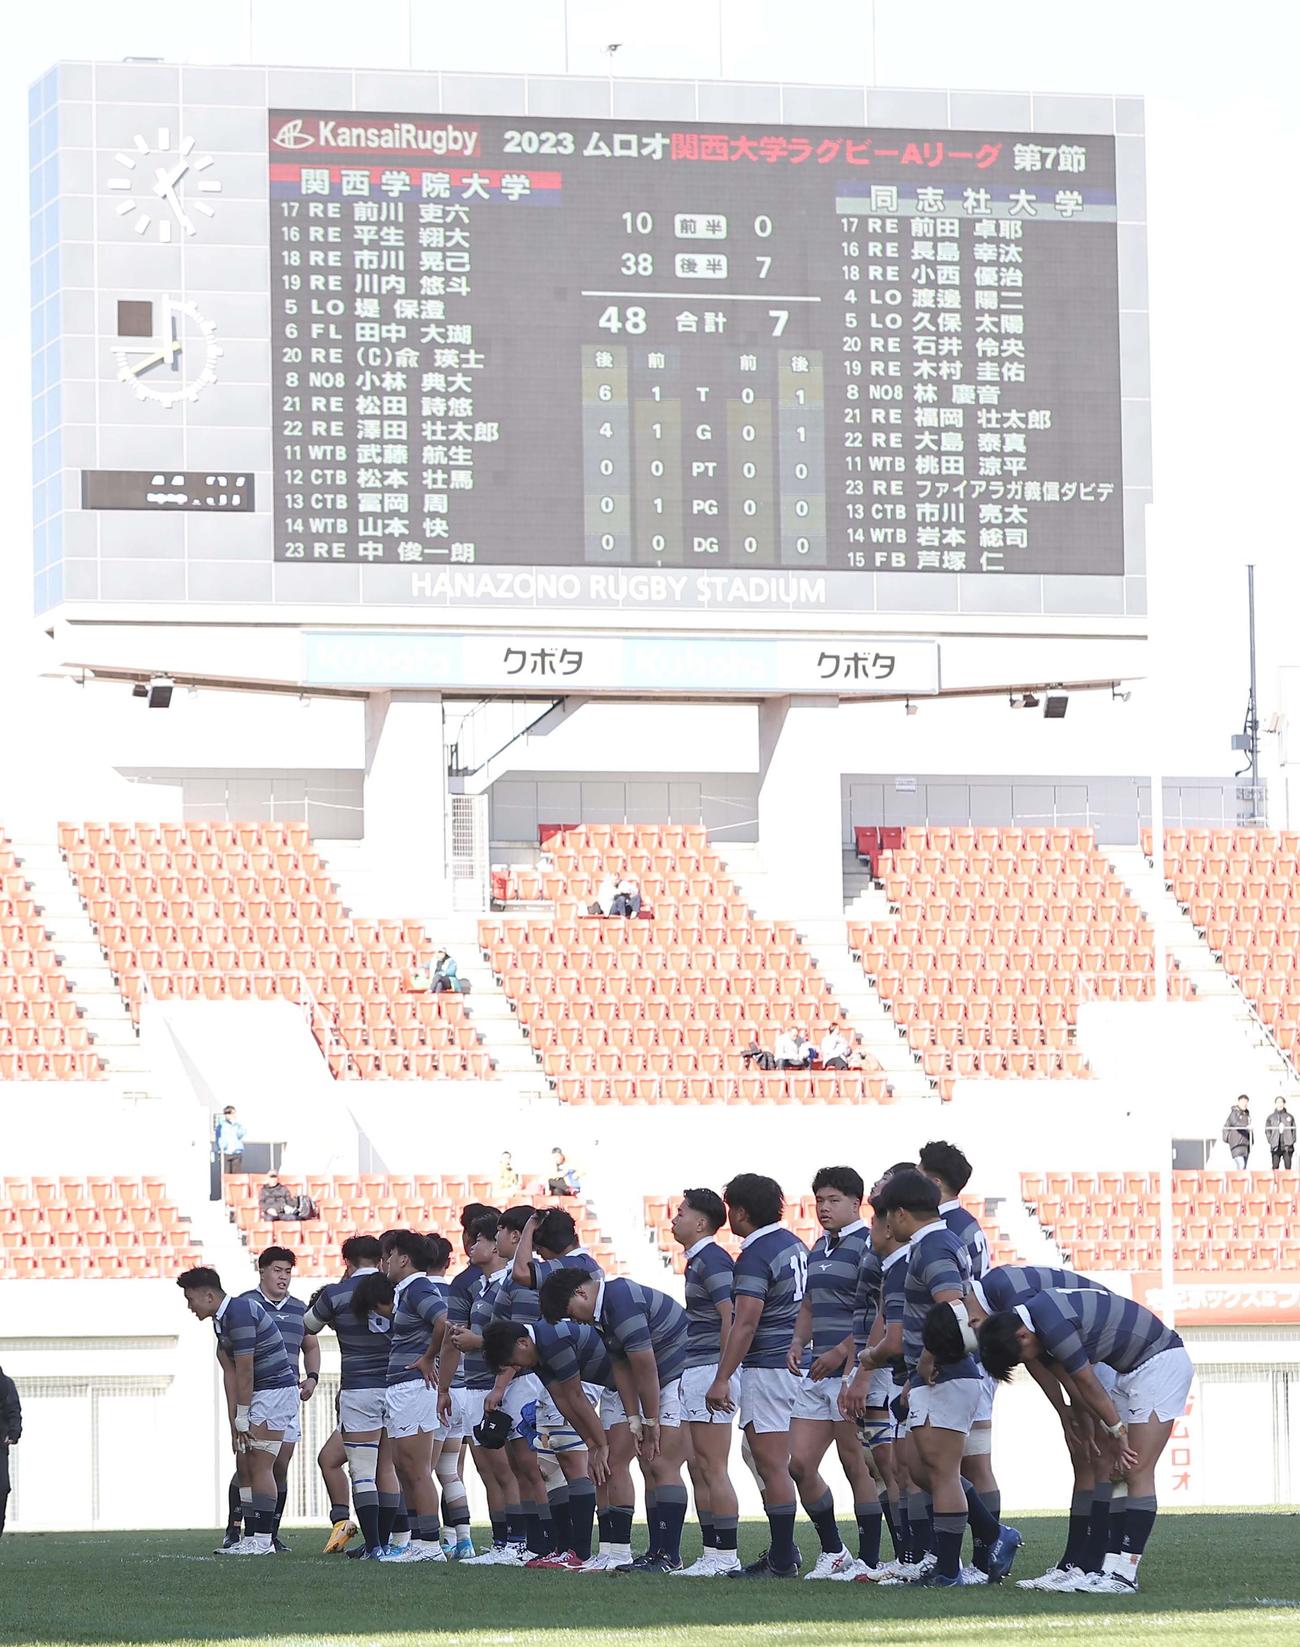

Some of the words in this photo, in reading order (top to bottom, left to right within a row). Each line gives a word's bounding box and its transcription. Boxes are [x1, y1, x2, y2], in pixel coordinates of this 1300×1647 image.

[319, 121, 477, 155] KansaiRugby
[503, 131, 575, 154] 2023
[1013, 143, 1086, 173] 第7節
[300, 168, 531, 200] 関西学院大学
[870, 185, 1083, 217] 同志社大学
[282, 202, 299, 216] 17
[310, 203, 340, 217] RE
[354, 202, 403, 222] 前川
[622, 212, 652, 233] 10
[680, 219, 722, 234] 前半
[755, 216, 772, 237] 0
[842, 218, 858, 232] 17
[869, 218, 898, 233] RE
[911, 217, 959, 237] 前田
[282, 227, 299, 241] 16
[310, 227, 341, 241] RE
[354, 226, 404, 246] 平生
[282, 251, 300, 265] 18
[310, 251, 341, 266] RE
[354, 250, 404, 270] 市川
[842, 242, 858, 256] 16
[869, 242, 898, 257] RE
[911, 241, 959, 261] 長島
[621, 253, 653, 275] 38
[681, 258, 722, 274] 後半
[756, 257, 771, 278] 7
[843, 266, 859, 280] 18
[869, 266, 899, 280] RE
[912, 265, 960, 285] 小西
[283, 275, 300, 289] 19
[310, 275, 341, 290] RE
[355, 274, 405, 294] 川内
[286, 299, 297, 314] 5
[312, 300, 344, 315] LO
[845, 290, 857, 303] 4
[871, 290, 901, 305] LO
[599, 306, 647, 334] 48
[676, 312, 727, 333] 合計
[769, 310, 788, 336] 7
[846, 313, 857, 327] 5
[871, 313, 902, 328] LO
[913, 312, 961, 332] 久保
[976, 314, 1023, 333] 太陽
[286, 323, 297, 338] 6
[312, 324, 342, 339] FL
[356, 323, 406, 343] 田中
[283, 348, 301, 362] 20
[312, 348, 342, 363] RE
[843, 337, 861, 351] 20
[871, 337, 900, 352] RE
[913, 336, 962, 356] 石井
[596, 352, 613, 367] 後
[648, 353, 664, 368] 前
[740, 355, 756, 371] 前
[792, 356, 808, 372] 後
[844, 361, 861, 375] 19
[871, 361, 900, 376] RE
[914, 360, 962, 380] 木村
[286, 372, 298, 387] 8
[310, 372, 344, 387] NO8
[356, 372, 406, 391] 小林
[421, 373, 472, 392] 典大
[600, 385, 611, 401] 6
[652, 387, 660, 401] 1
[697, 387, 709, 401] T
[742, 388, 754, 403] 0
[796, 390, 805, 404] 1
[847, 385, 858, 399] 8
[870, 385, 902, 400] NO8
[914, 384, 937, 403] 林
[284, 396, 300, 411] 21
[312, 397, 343, 411] RE
[356, 396, 407, 415] 松田
[845, 408, 859, 423] 21
[872, 409, 901, 423] RE
[914, 407, 963, 427] 福岡
[978, 409, 1051, 429] 壮太郎
[284, 421, 302, 435] 22
[312, 421, 343, 436] RE
[422, 422, 498, 442] 壮太郎
[600, 423, 612, 437] 4
[653, 424, 661, 438] 1
[697, 425, 711, 439] G
[743, 426, 754, 441] 0
[797, 427, 805, 441] 1
[845, 432, 862, 447] 22
[872, 433, 902, 447] RE
[915, 432, 963, 451] 大島
[285, 446, 300, 459] 11
[309, 446, 346, 460] WTB
[357, 445, 407, 464] 武藤
[423, 446, 473, 465] 航生
[846, 457, 860, 471] 11
[869, 457, 905, 471] WTB
[915, 455, 964, 475] 桃田
[285, 470, 302, 484] 12
[311, 469, 346, 484] CTB
[357, 469, 408, 488] 松本
[423, 471, 473, 489] 壮馬
[601, 460, 612, 475] 0
[651, 461, 663, 476] 0
[693, 463, 716, 476] PT
[744, 463, 755, 478] 0
[796, 464, 807, 479] 0
[846, 480, 863, 494] 23
[874, 481, 903, 495] RE
[286, 494, 303, 508] 13
[311, 494, 347, 509] CTB
[424, 495, 447, 513] 周
[601, 497, 613, 512] 0
[654, 499, 662, 513] 1
[693, 500, 718, 514] PG
[744, 500, 756, 515] 0
[796, 501, 808, 516] 0
[847, 504, 863, 519] 13
[872, 504, 906, 519] CTB
[916, 503, 964, 523] 市川
[286, 519, 304, 532] 14
[309, 518, 347, 533] WTB
[359, 518, 409, 537] 山本
[423, 519, 448, 537] 快
[848, 528, 864, 542] 14
[871, 528, 906, 543] WTB
[917, 527, 965, 546] 岩本
[286, 543, 304, 557] 23
[314, 543, 345, 558] RE
[359, 542, 383, 561] 中
[602, 535, 613, 550] 0
[653, 536, 664, 551] 0
[694, 538, 718, 552] DG
[745, 537, 756, 552] 0
[797, 538, 809, 553] 0
[848, 552, 864, 566] 15
[875, 552, 905, 567] FB
[980, 552, 1004, 571] 仁
[411, 573, 580, 600] HANAZONO
[589, 576, 687, 601] RUGBY
[697, 577, 827, 604] STADIUM
[503, 646, 583, 675] クボタ
[817, 652, 896, 679] クボタ
